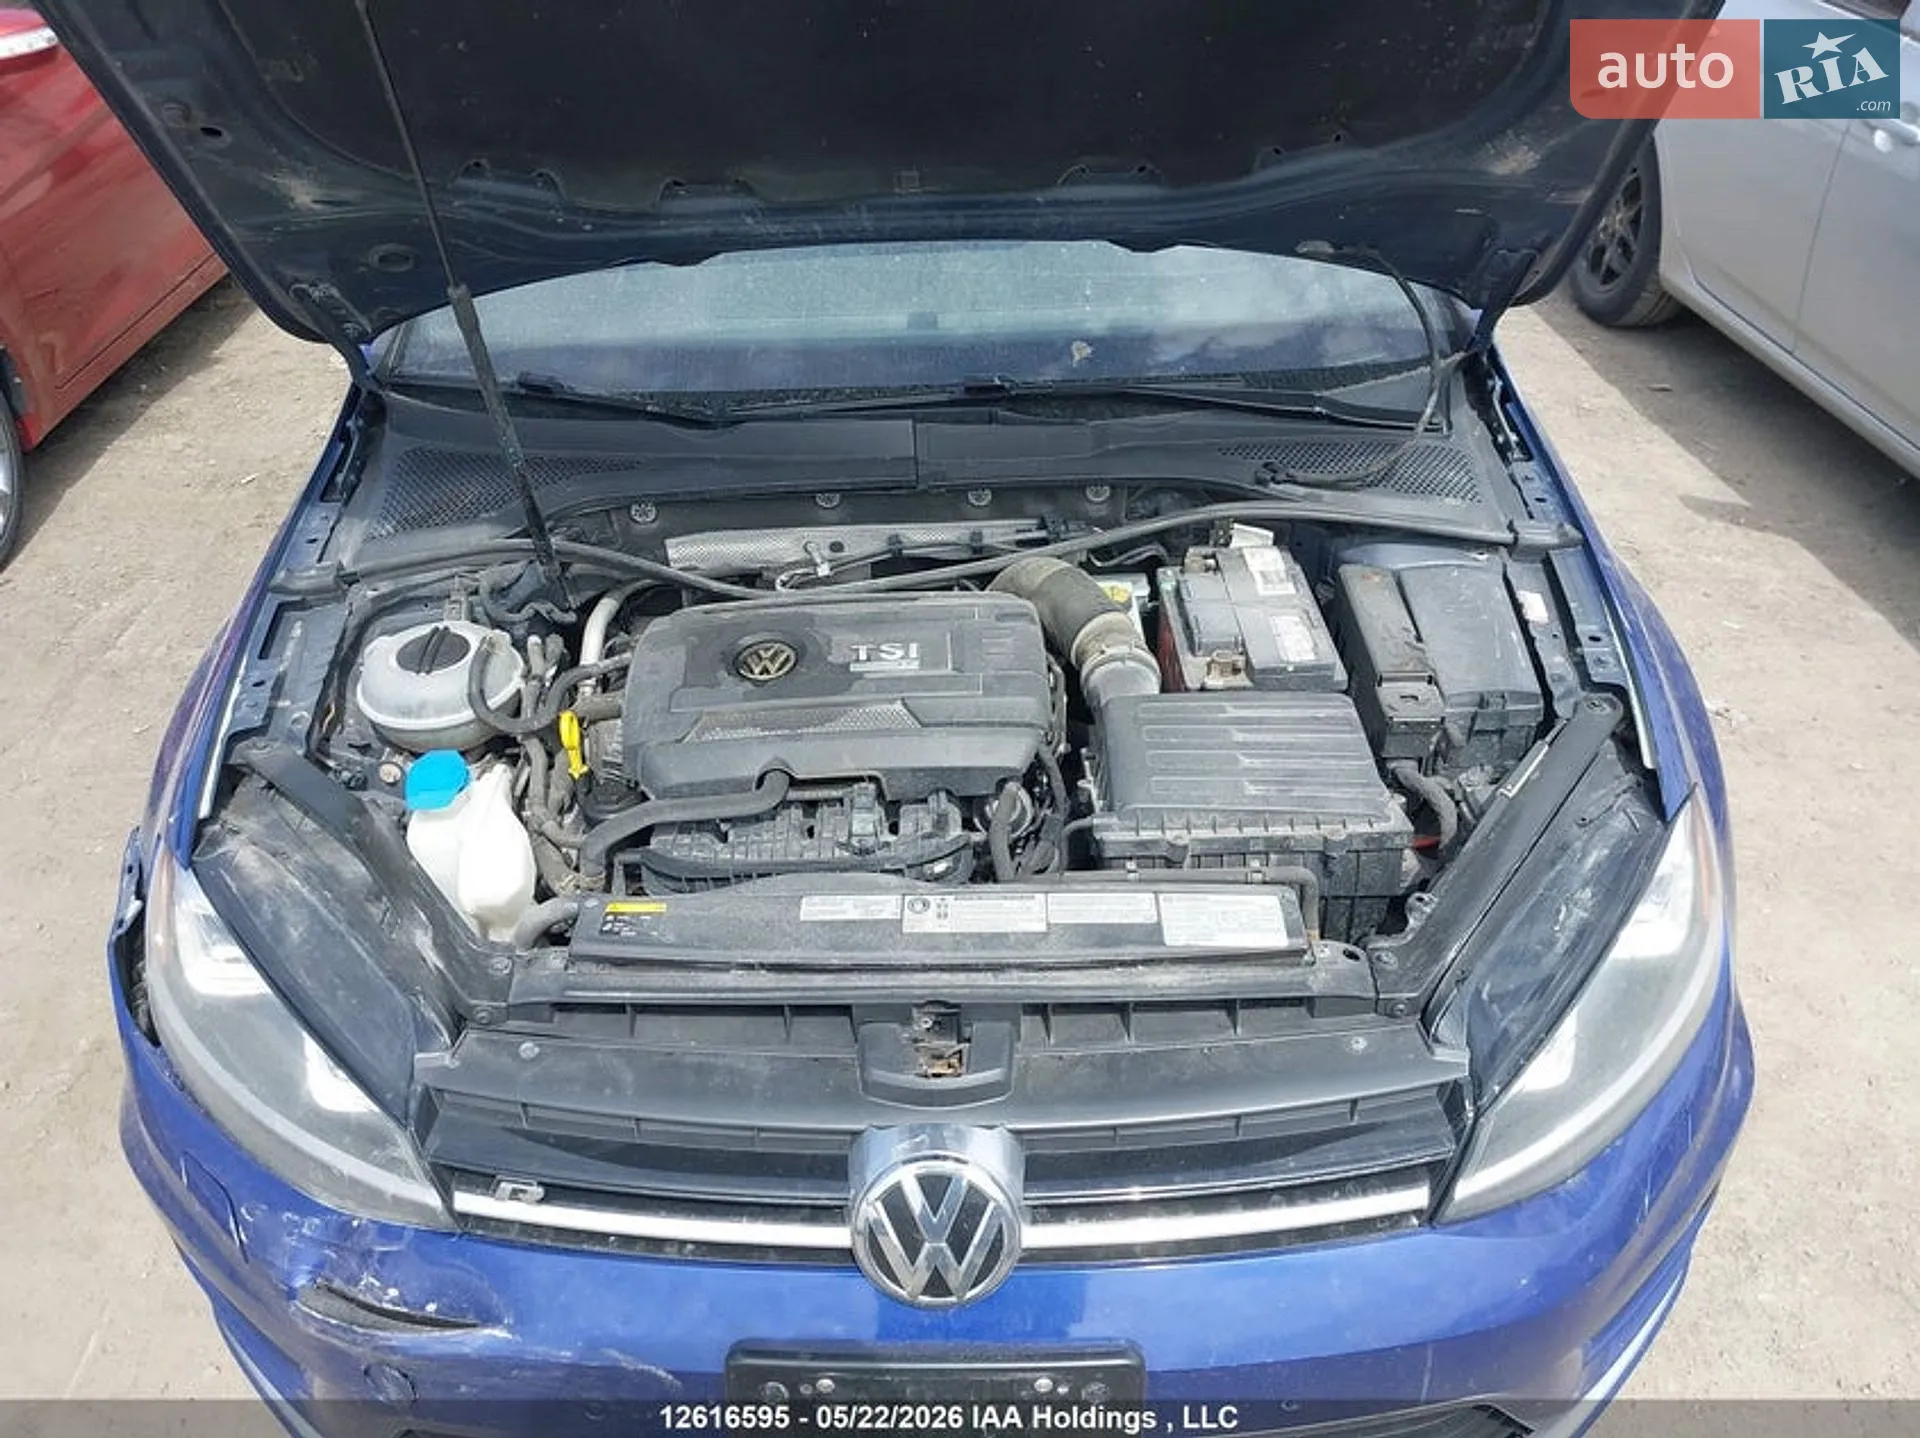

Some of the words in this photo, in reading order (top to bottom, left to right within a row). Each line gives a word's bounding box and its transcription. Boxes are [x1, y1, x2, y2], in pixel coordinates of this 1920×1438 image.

[738, 641, 797, 680] VW
[851, 642, 920, 662] TSI
[860, 1159, 1013, 1305] VW
